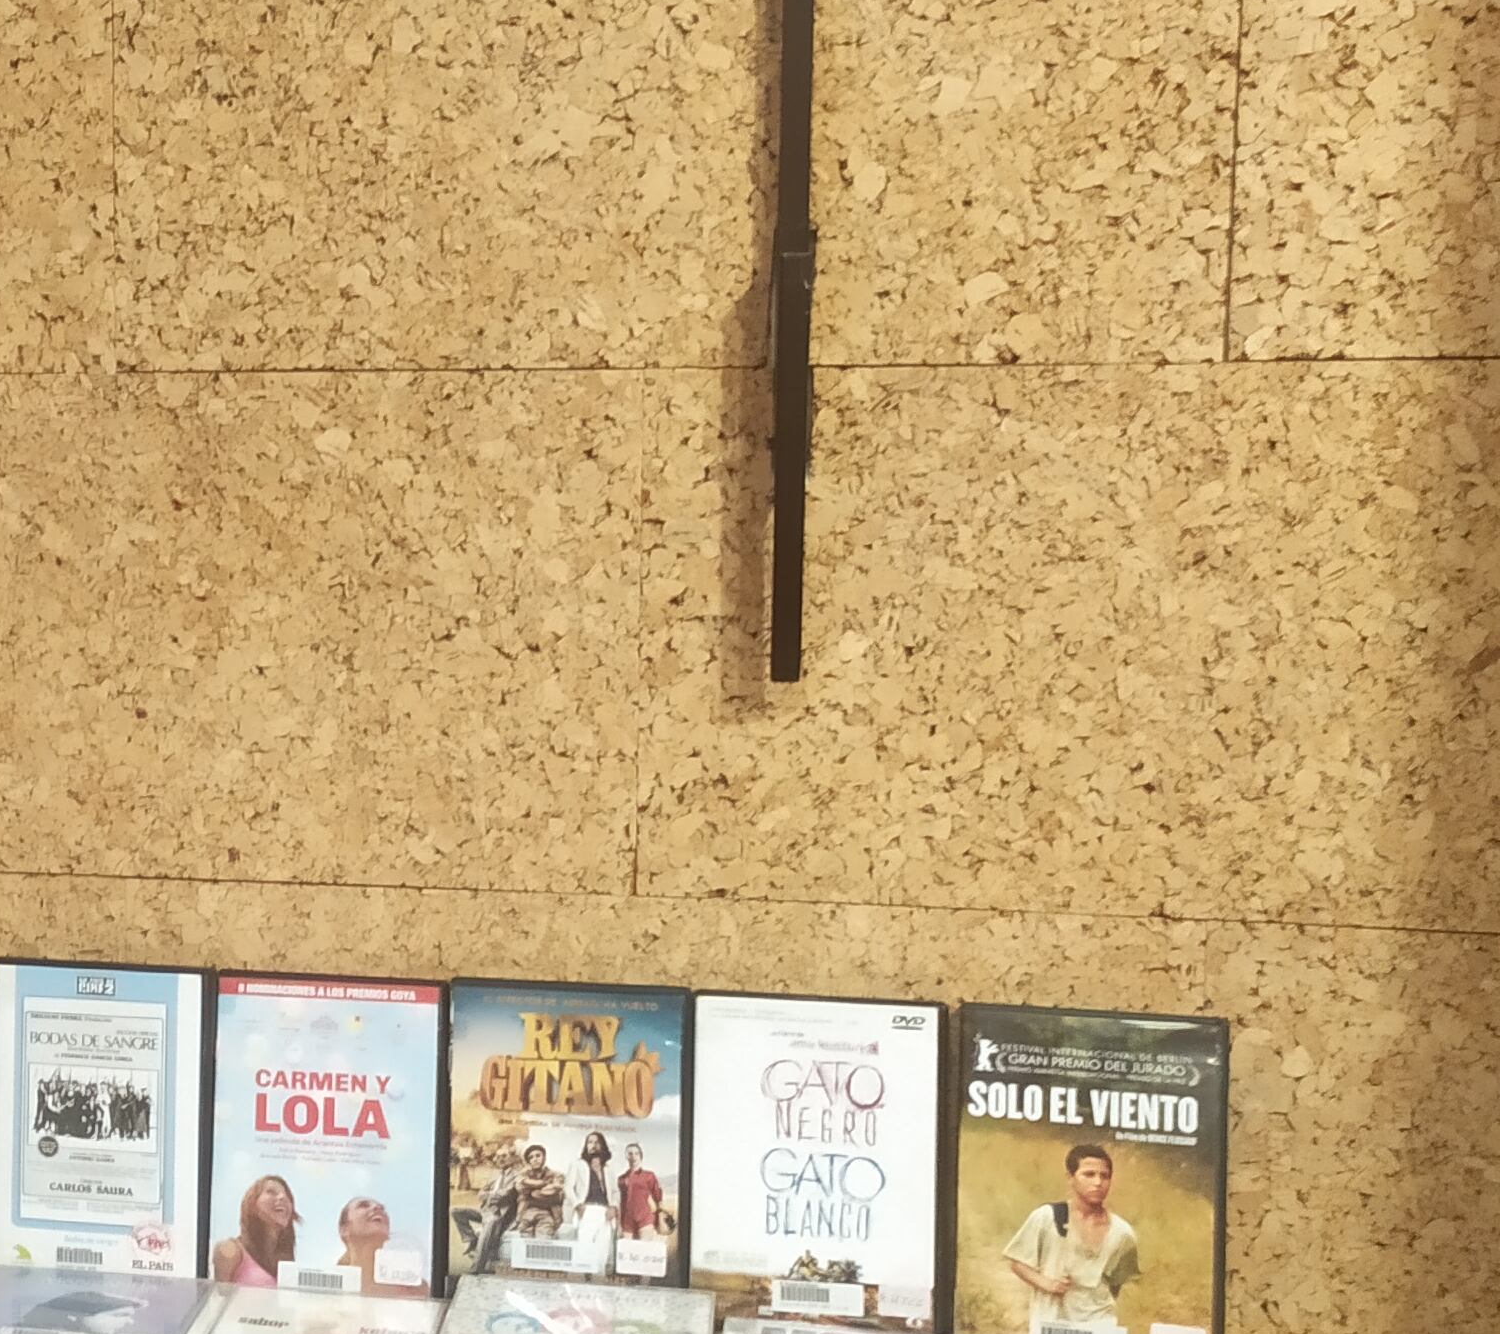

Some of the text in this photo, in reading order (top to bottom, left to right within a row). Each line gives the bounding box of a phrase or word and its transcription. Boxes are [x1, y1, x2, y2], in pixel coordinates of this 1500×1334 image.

[316, 987, 324, 996] A
[326, 987, 344, 998] LOS
[346, 988, 389, 1000] PREMIOS
[390, 990, 416, 1001] GOYA
[518, 1011, 622, 1061] REY
[891, 1015, 926, 1030] DVD
[30, 1031, 158, 1051] BODAS DE SANGRE
[1000, 1043, 1044, 1055] FESTIVAL
[1050, 1045, 1135, 1061] INTERNACIONAL
[254, 1068, 391, 1094] CARMEN Y
[1007, 1054, 1186, 1076] GRAN PREMIO DEL JURADO
[479, 1056, 654, 1119] GITANO
[760, 1059, 885, 1110] GATO
[254, 1093, 391, 1139] LOLA
[775, 1100, 877, 1148] NEGRO
[967, 1080, 1199, 1133] SOLO EL VIENTO
[49, 1182, 133, 1196] CARLOS SAURA
[760, 1147, 886, 1203] GATO
[765, 1194, 871, 1241] BLANCO
[238, 1316, 290, 1328] sabor
